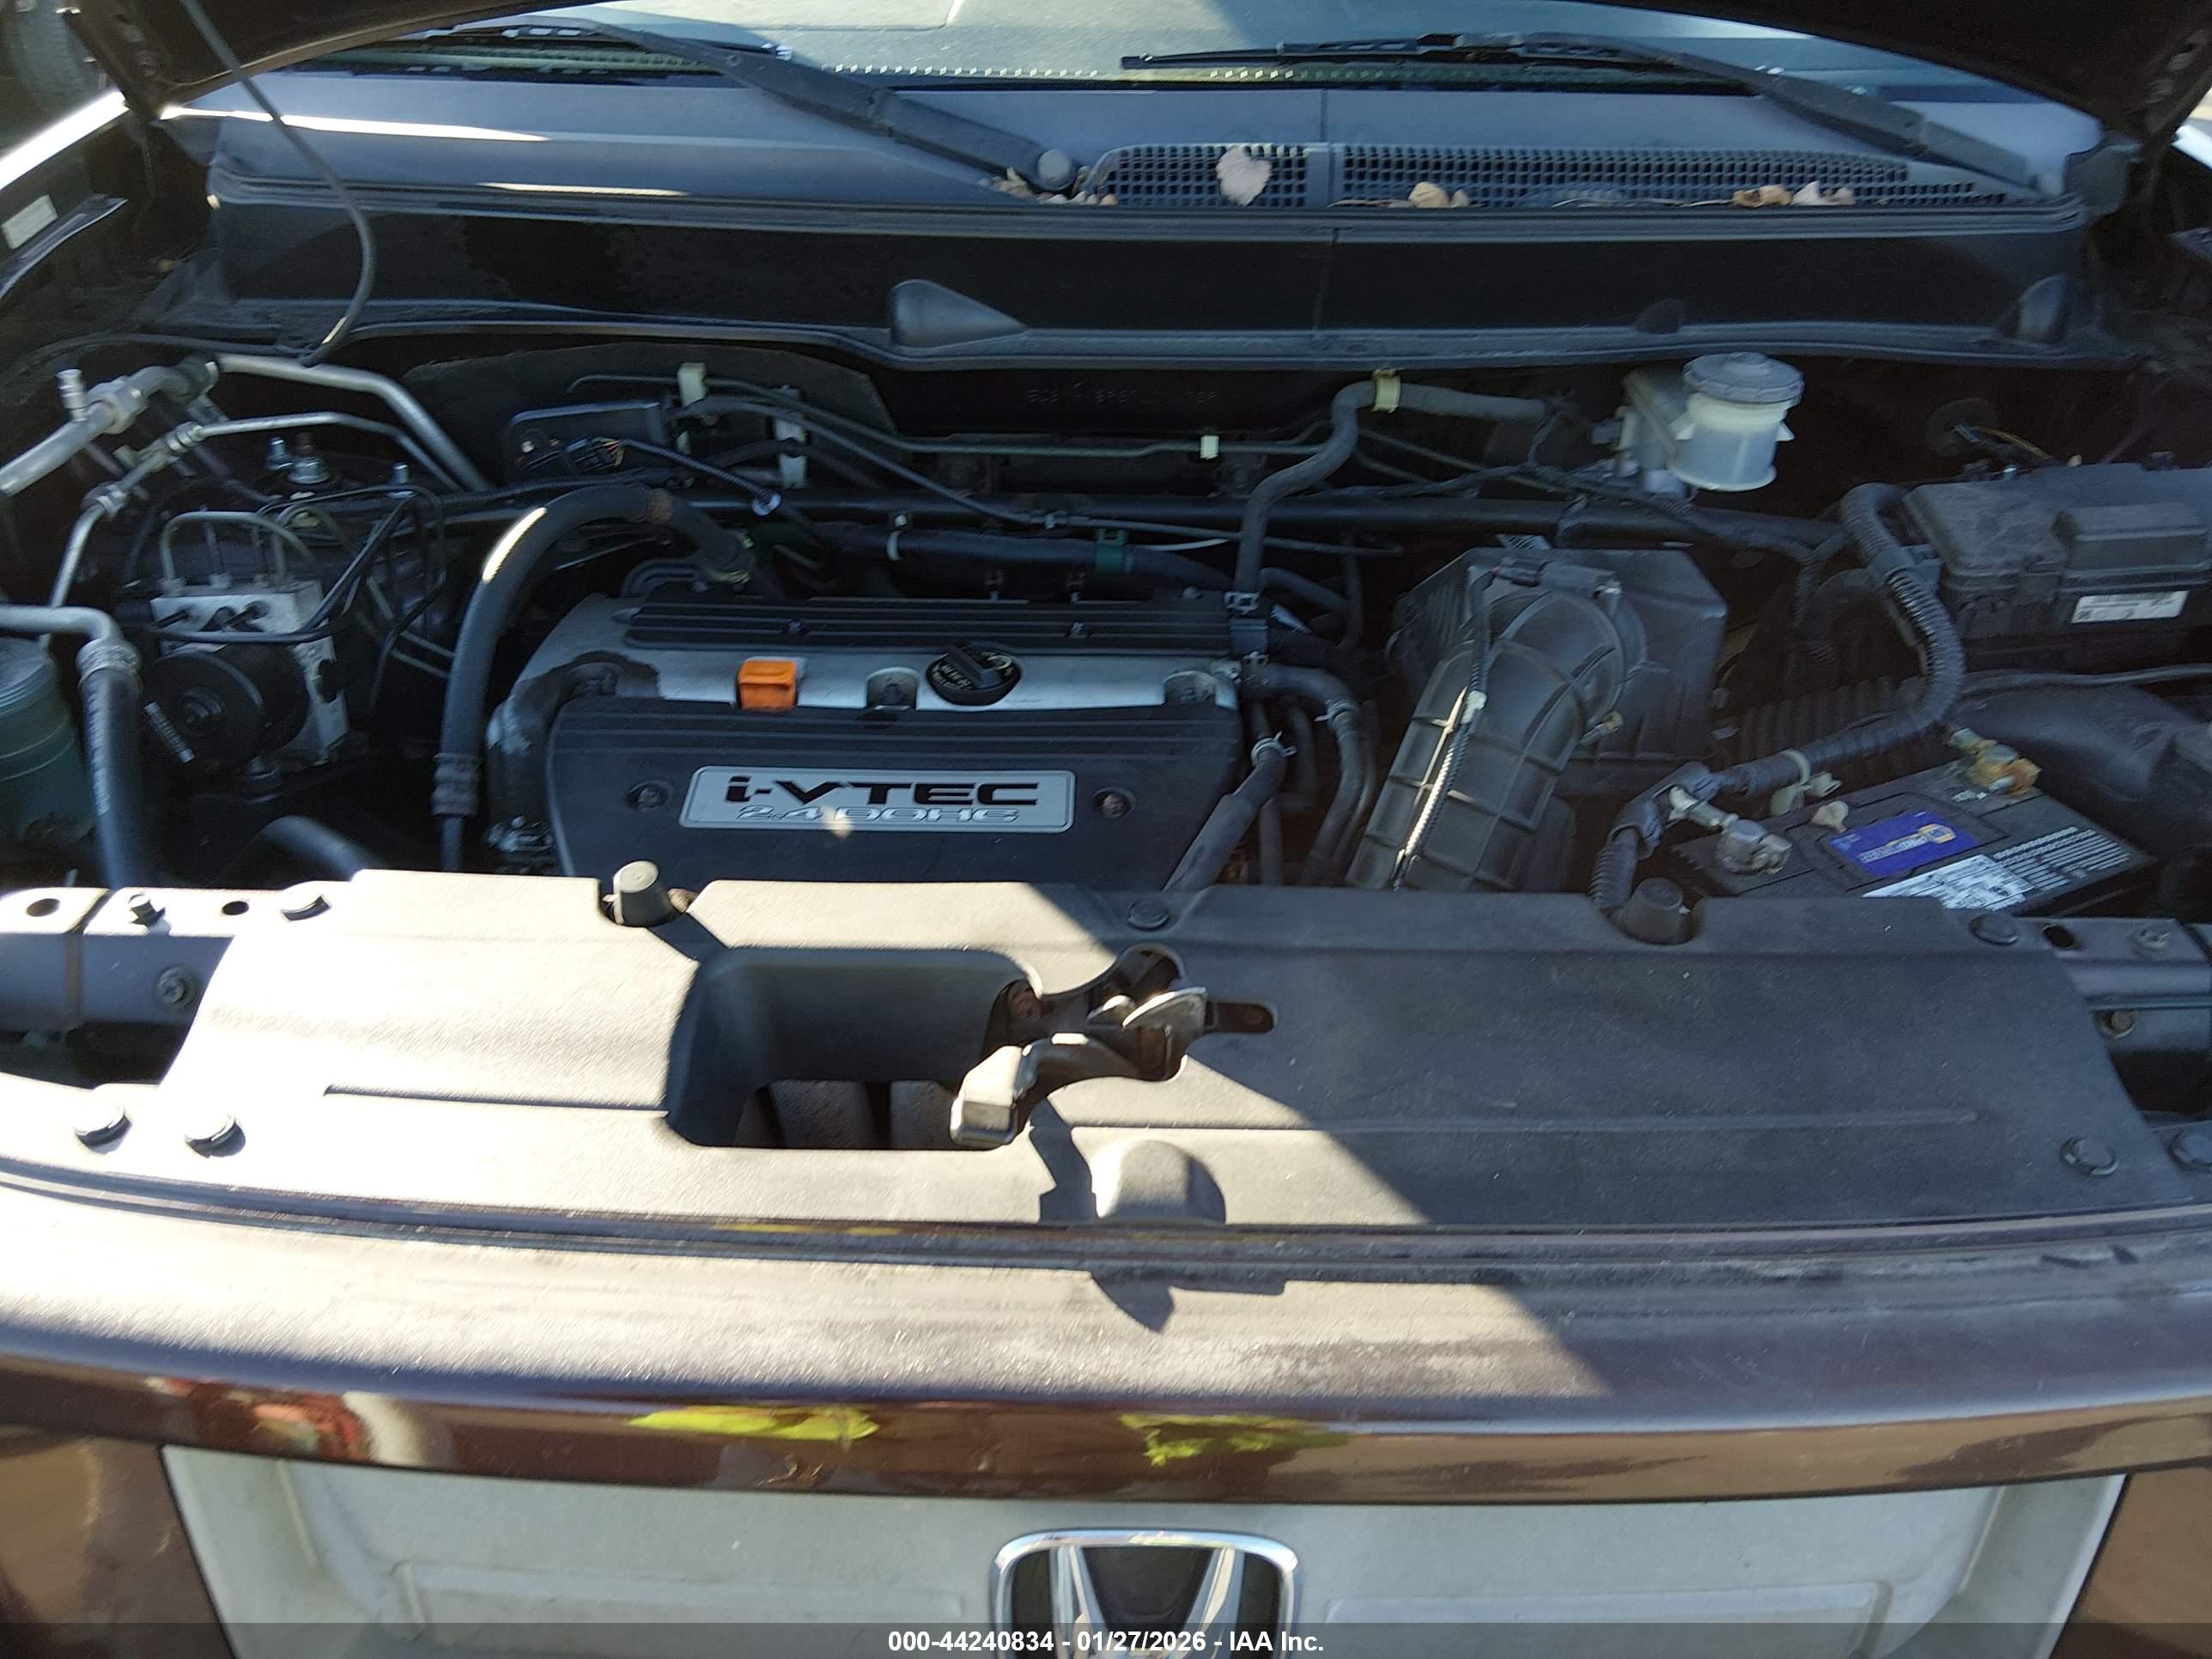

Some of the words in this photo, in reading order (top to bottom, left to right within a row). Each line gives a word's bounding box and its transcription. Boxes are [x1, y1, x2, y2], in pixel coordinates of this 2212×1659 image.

[724, 776, 1040, 805] i-VTEC
[737, 805, 823, 820] 2.4
[835, 806, 1019, 822] DOHC
